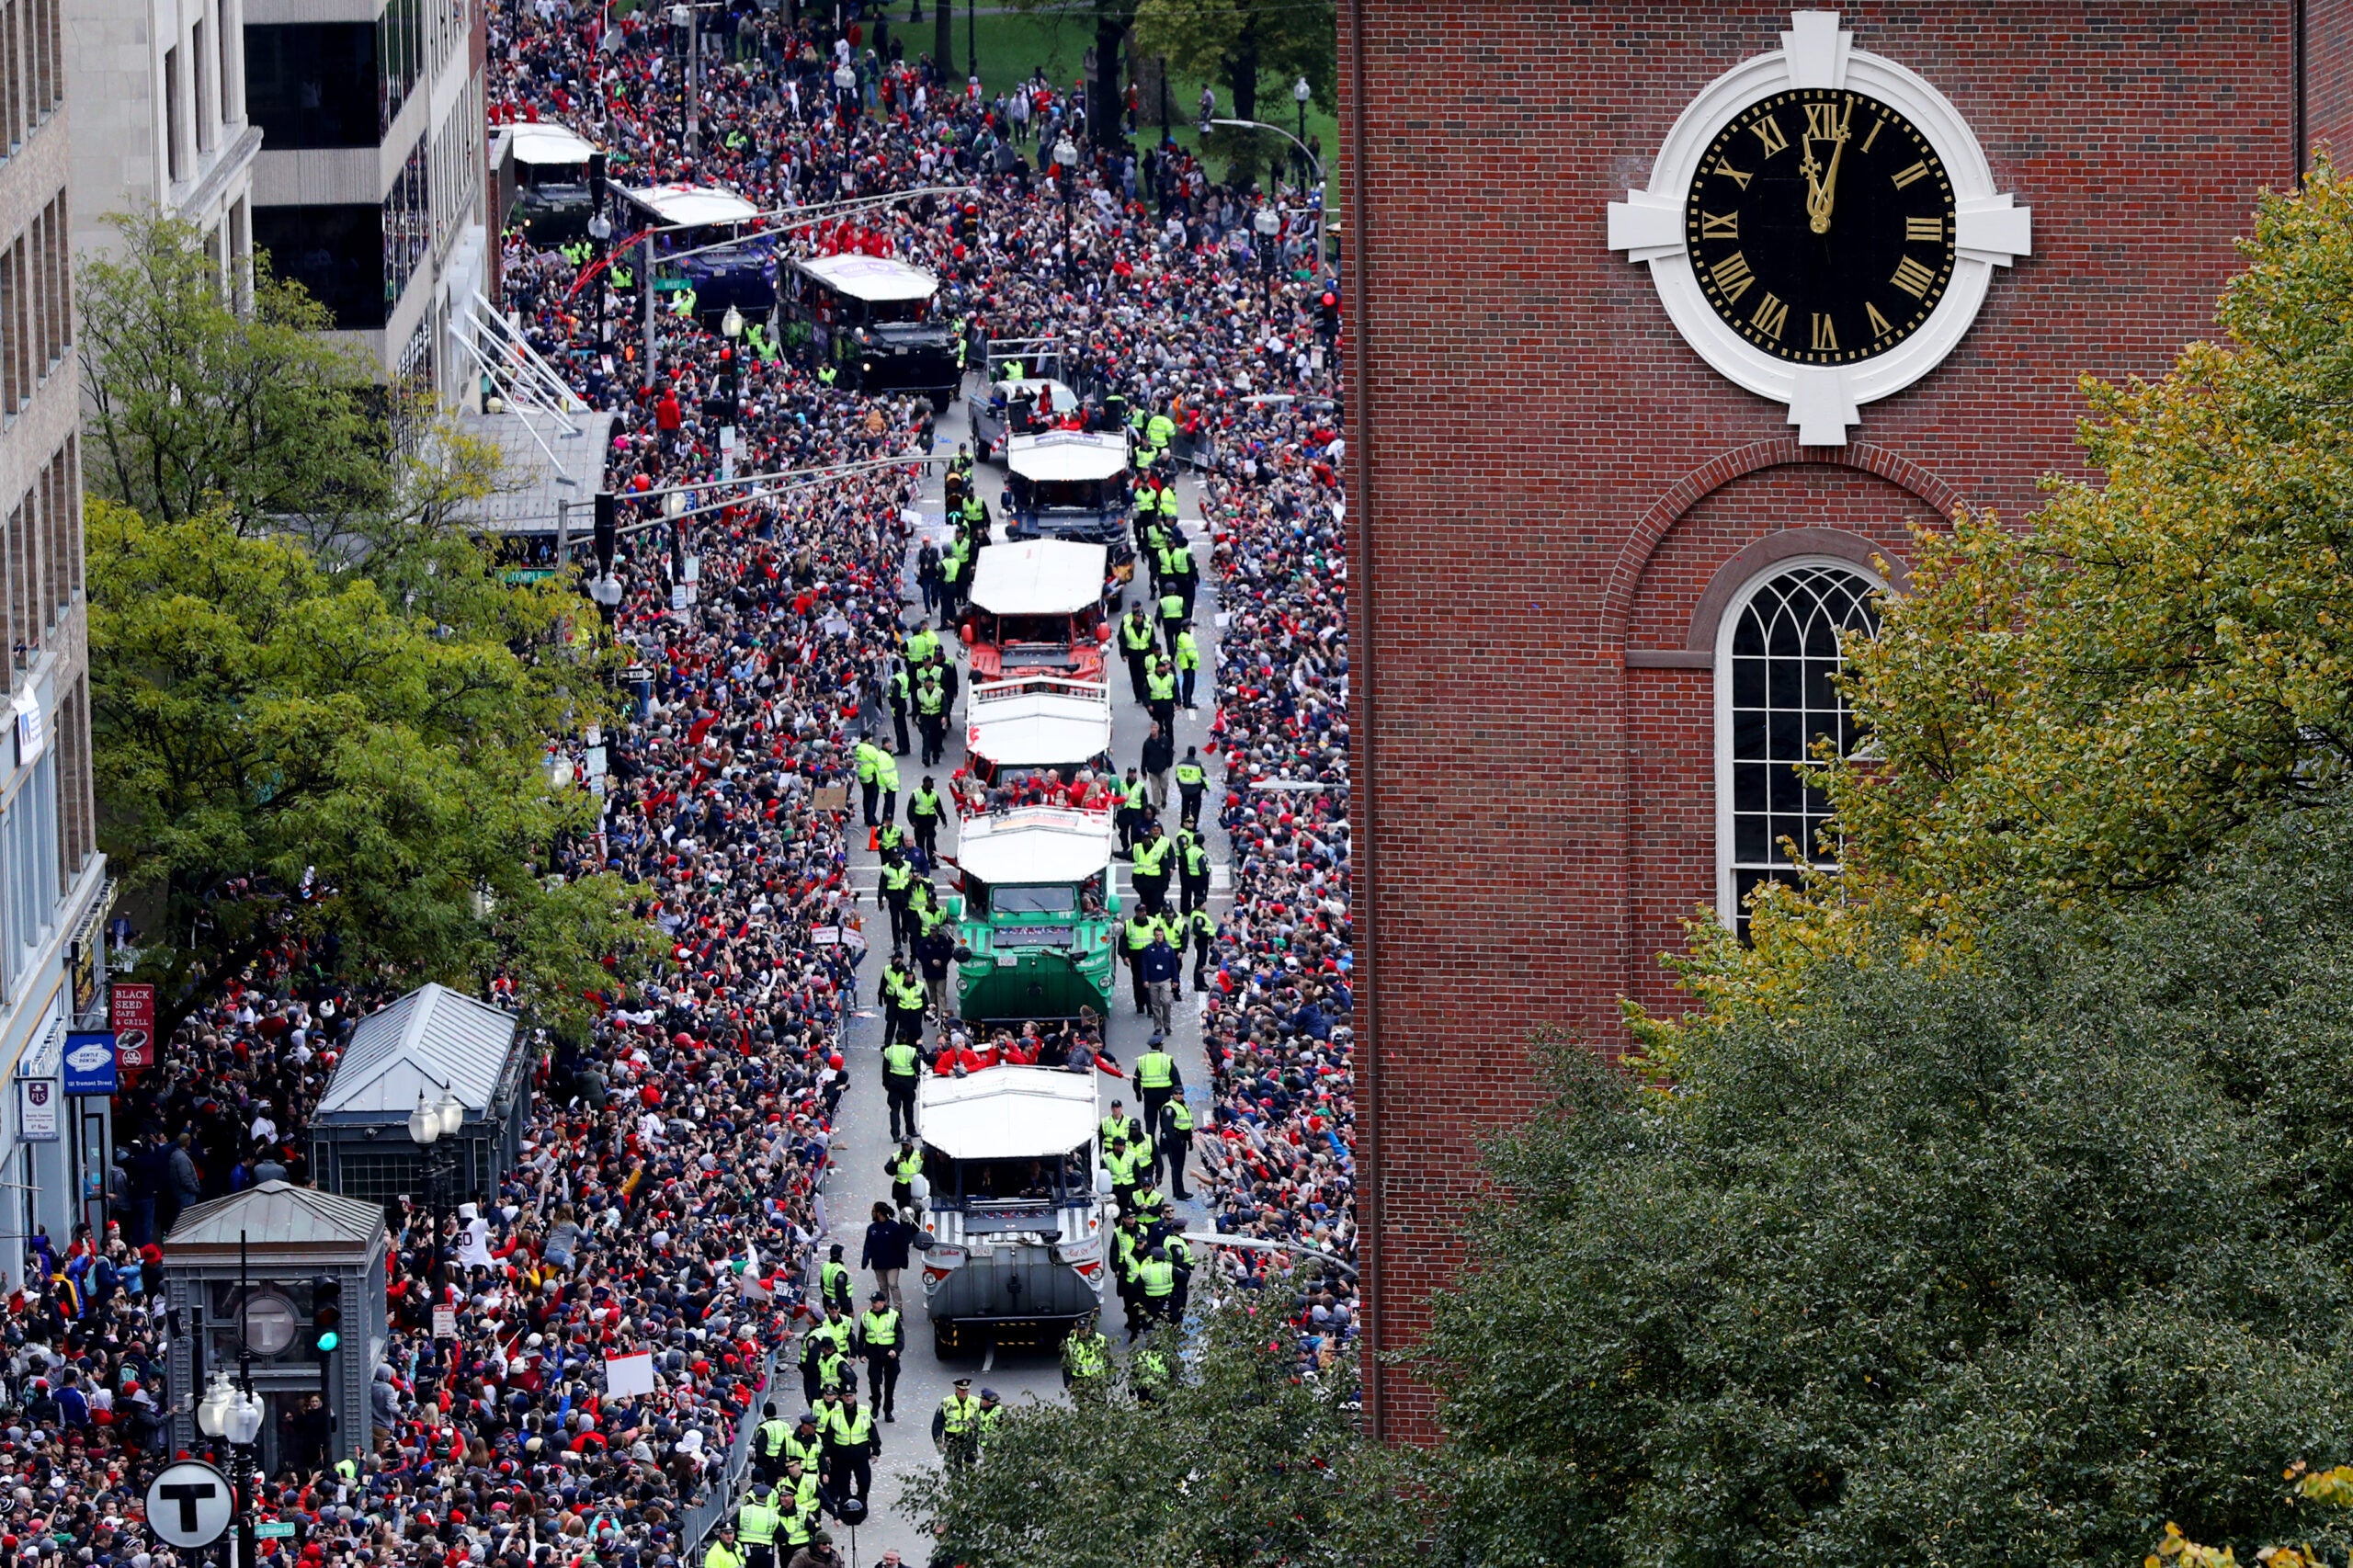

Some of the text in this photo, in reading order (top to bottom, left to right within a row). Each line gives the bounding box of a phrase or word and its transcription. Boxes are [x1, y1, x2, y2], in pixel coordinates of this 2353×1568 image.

[1749, 114, 1790, 160] XI
[1713, 155, 1754, 191] X
[1891, 159, 1929, 190] II
[1701, 210, 1739, 240] IX
[1905, 216, 1943, 242] III
[665, 280, 680, 290] WEST
[1710, 250, 1756, 306] VIII
[1749, 292, 1789, 341] VII
[1811, 312, 1839, 350] VI
[1864, 301, 1893, 338] V
[115, 991, 150, 1000] BLACK
[115, 1000, 142, 1009] SEED
[31, 1092, 46, 1103] FLS
[247, 1312, 285, 1346] T
[160, 1483, 216, 1532] T
